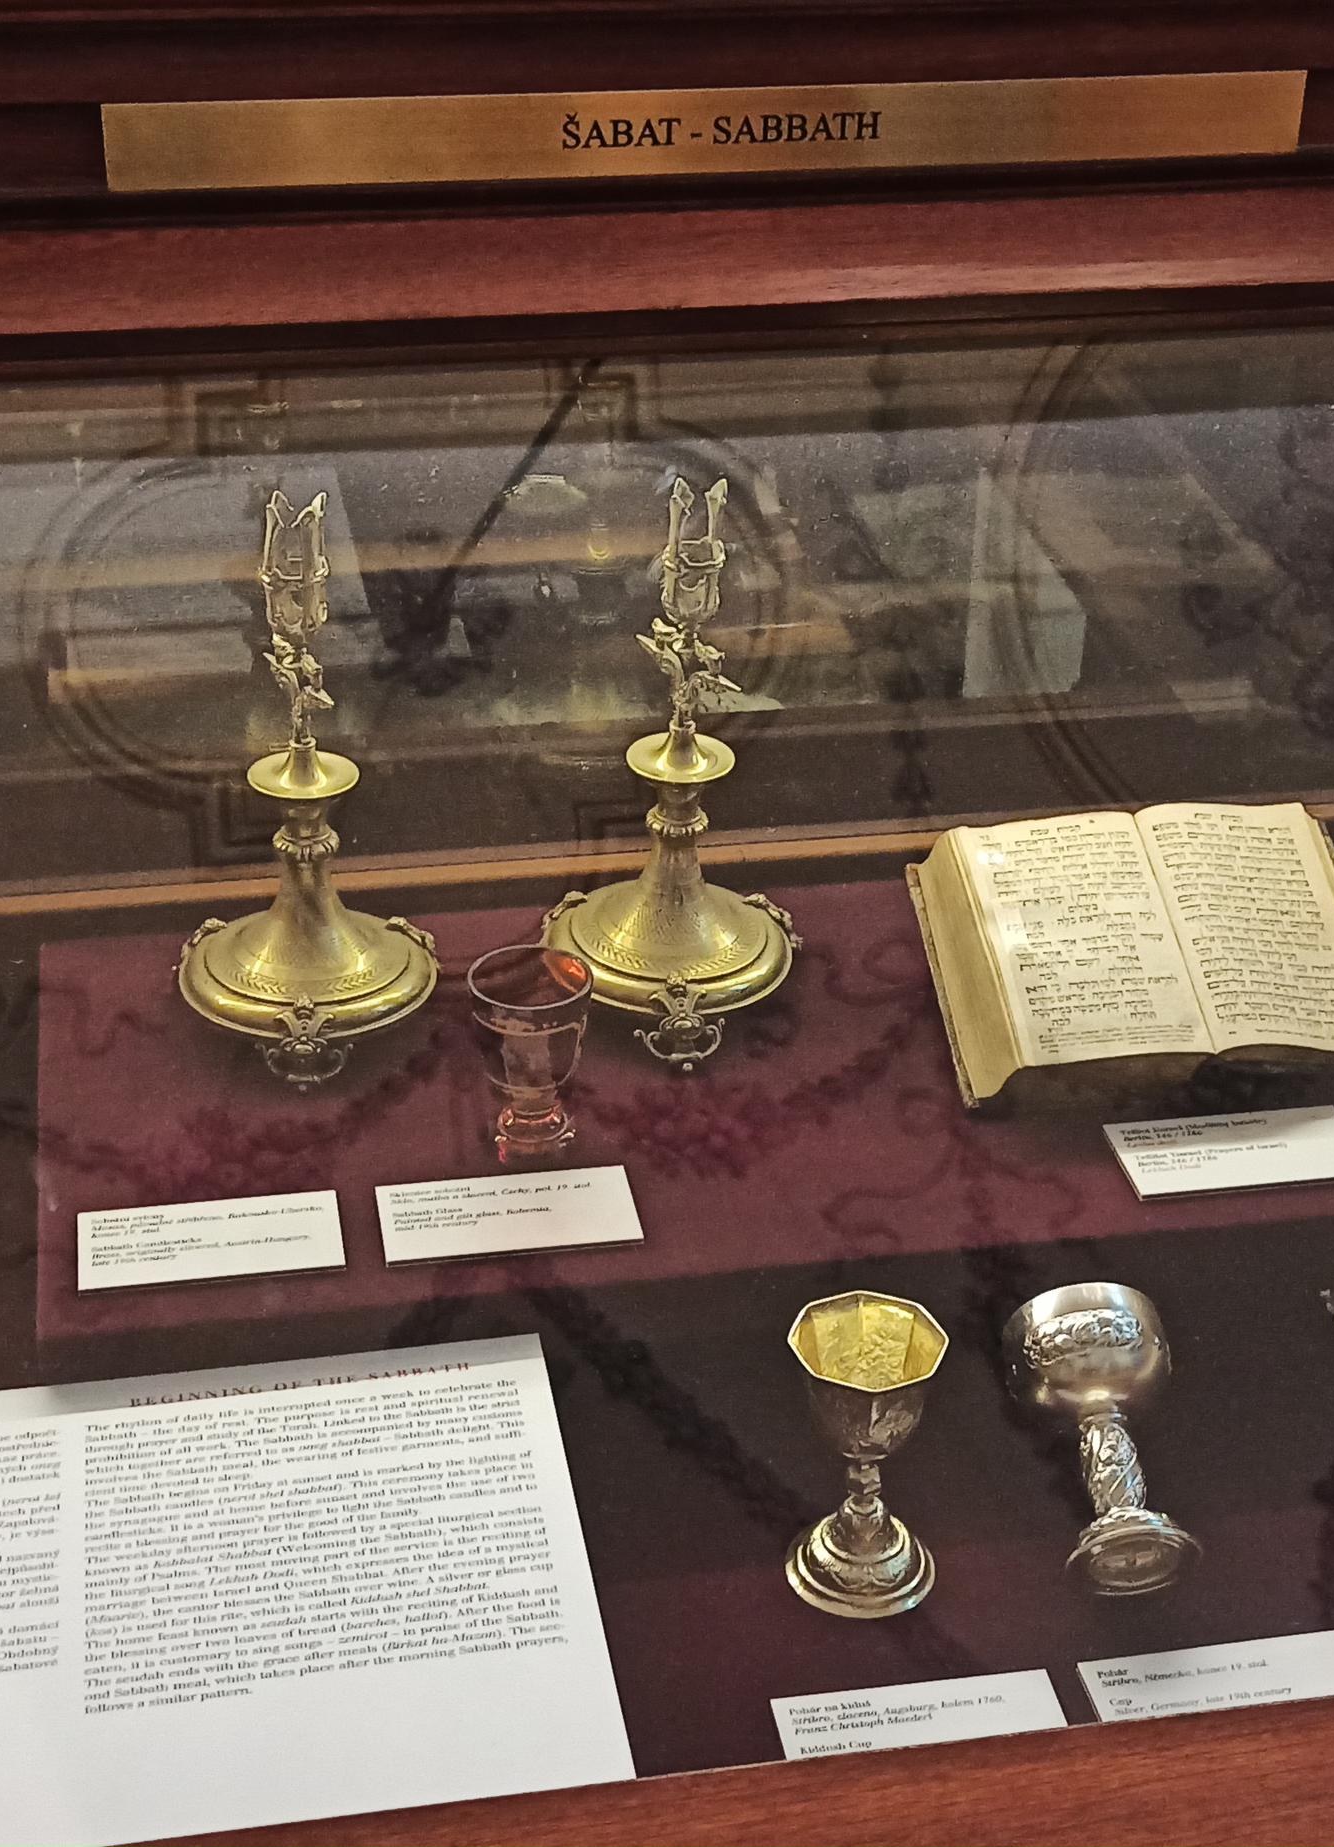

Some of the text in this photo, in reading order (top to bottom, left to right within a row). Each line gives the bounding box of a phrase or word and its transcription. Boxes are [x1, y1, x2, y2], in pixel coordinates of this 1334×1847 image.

[562, 112, 681, 150] ŠABAT
[713, 111, 882, 144] SABBATH
[84, 1421, 109, 1432] The
[182, 1409, 213, 1422] daily
[218, 1407, 238, 1417] life
[257, 1397, 331, 1414] interrupted
[334, 1395, 365, 1404] once
[380, 1388, 414, 1399] week
[433, 1379, 492, 1393] celebrate
[495, 1377, 516, 1386] the
[130, 1362, 471, 1407] BEGINNING OF THE SABBATH
[84, 1596, 146, 1615] marriage
[151, 1588, 208, 1605] between
[212, 1583, 251, 1597] Israel
[254, 1580, 279, 1592] and
[282, 1574, 327, 1590] Queen
[391, 1562, 424, 1575] After
[427, 1560, 449, 1571] the
[452, 1553, 505, 1570] evening
[507, 1549, 551, 1563] prayer
